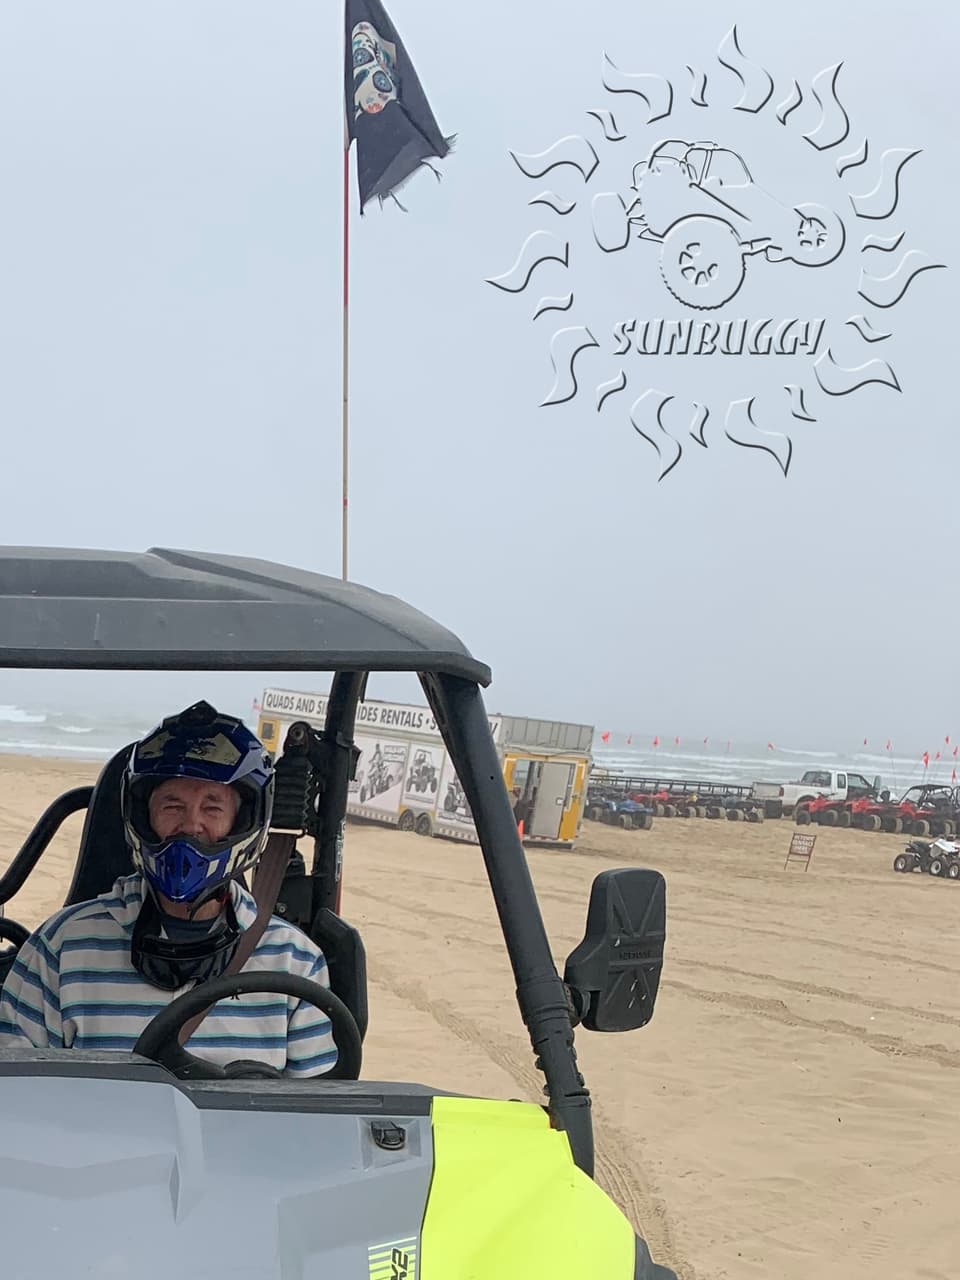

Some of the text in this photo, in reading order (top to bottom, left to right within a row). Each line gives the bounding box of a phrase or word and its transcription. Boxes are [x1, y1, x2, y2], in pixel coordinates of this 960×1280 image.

[266, 693, 294, 711] QUADS
[296, 697, 315, 713] AND
[357, 704, 380, 722] IDES
[380, 708, 424, 729] RENTALS
